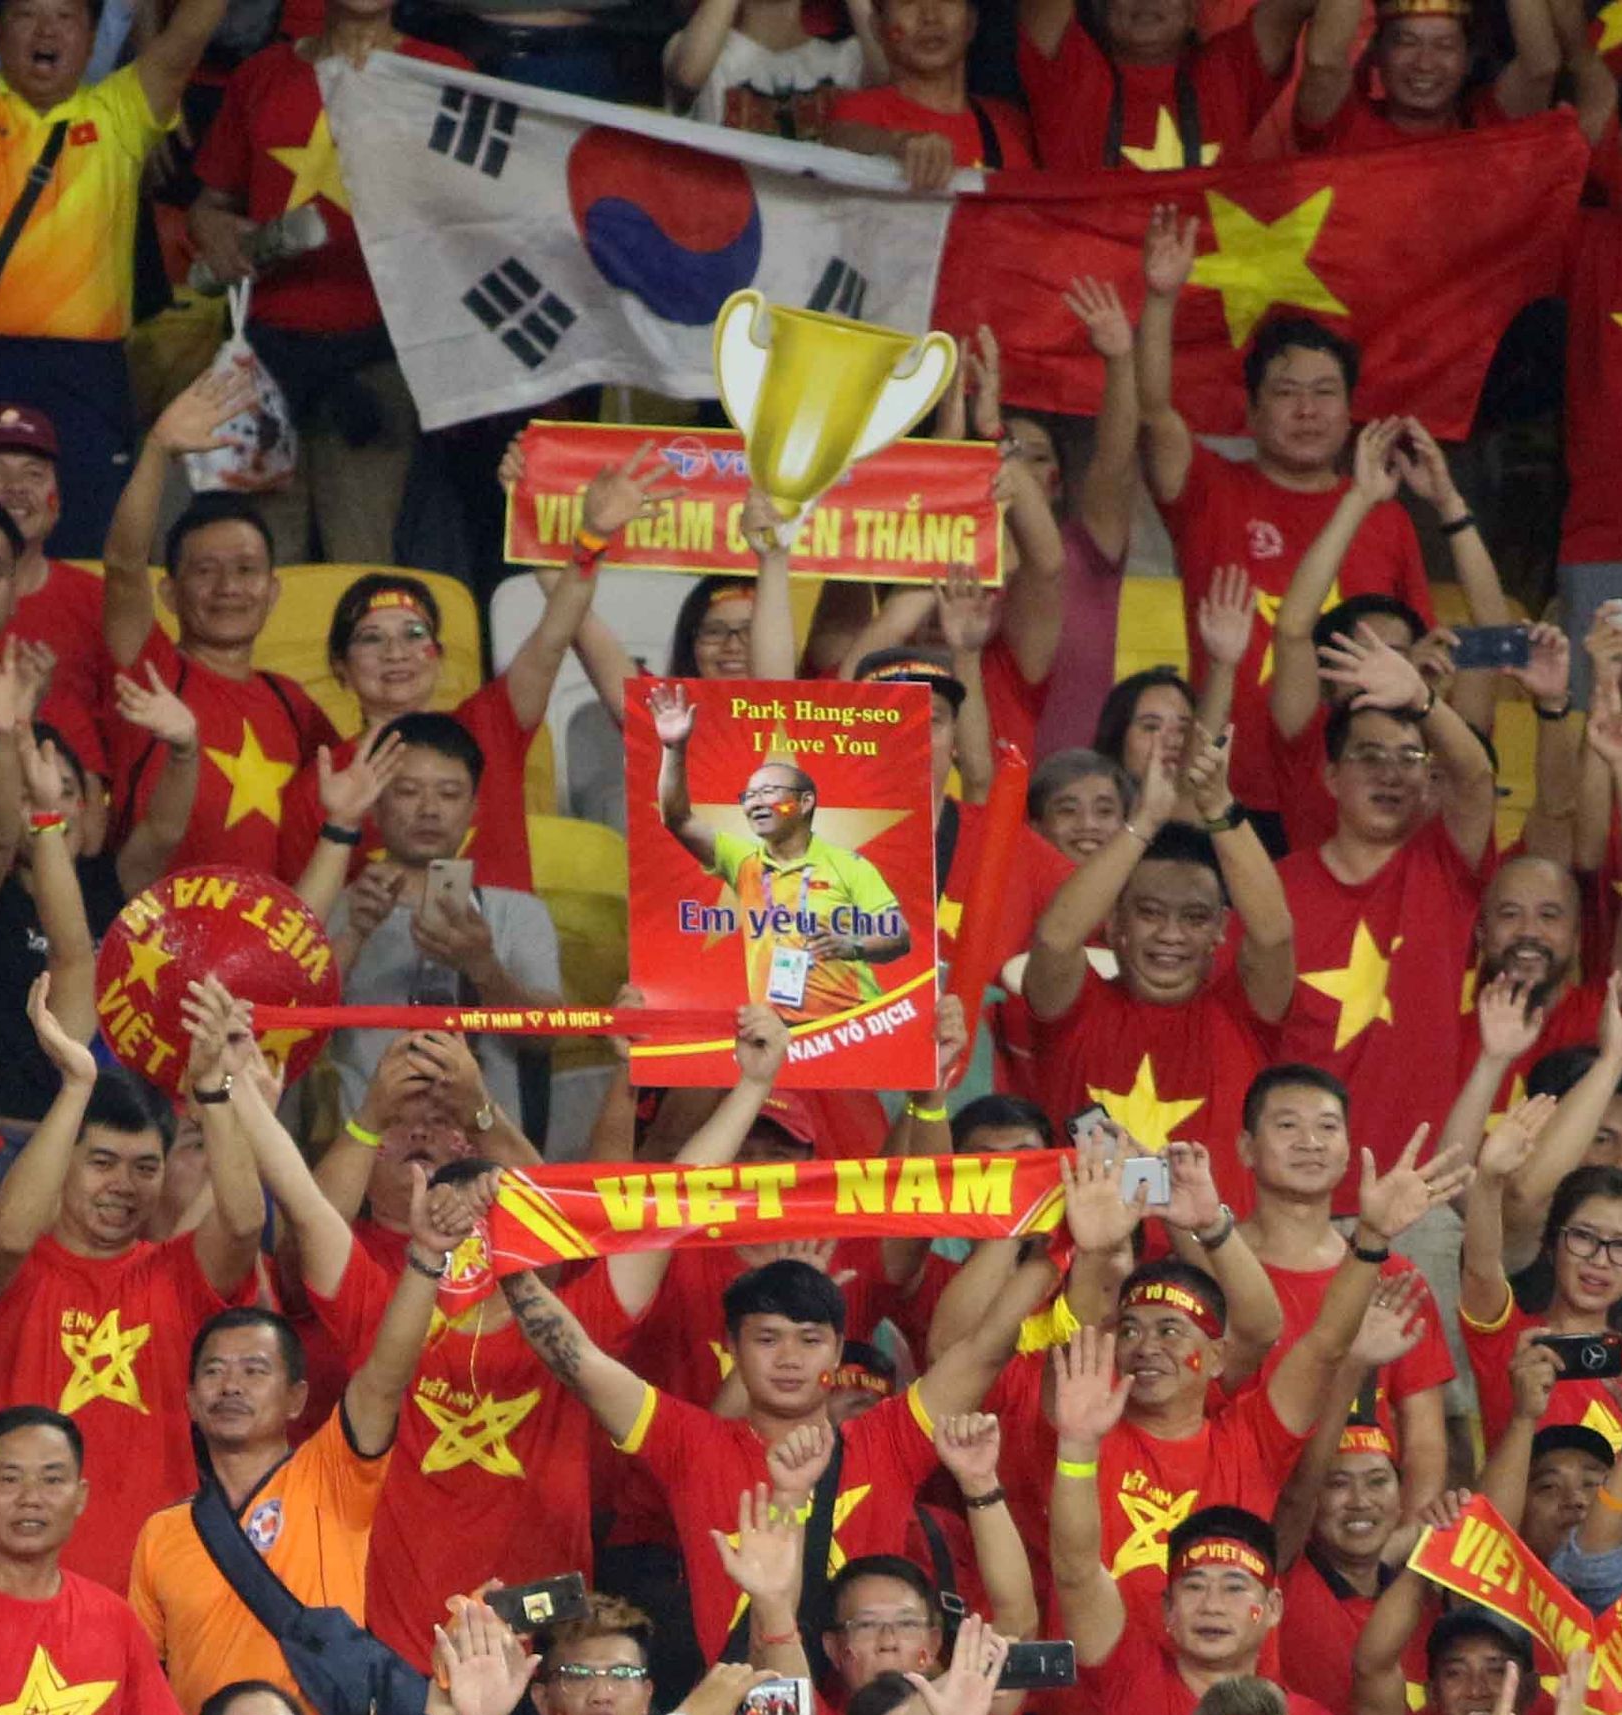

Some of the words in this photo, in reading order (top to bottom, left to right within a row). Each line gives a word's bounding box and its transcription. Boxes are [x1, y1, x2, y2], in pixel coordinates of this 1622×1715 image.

[534, 486, 587, 546] VI
[623, 499, 715, 553] NAM
[730, 697, 789, 721] Park
[793, 699, 901, 728] Hang-seo
[752, 731, 764, 753] I
[770, 731, 827, 755] Love
[832, 734, 878, 757] You
[678, 900, 738, 934] Em
[747, 902, 818, 941] yêu
[491, 1012, 523, 1028] NAM
[786, 1035, 834, 1064] NAM
[832, 1014, 866, 1047] VÔ
[594, 1166, 795, 1238] VIỆT
[833, 1158, 1013, 1216] NAM
[1450, 1514, 1525, 1597] VIỆT
